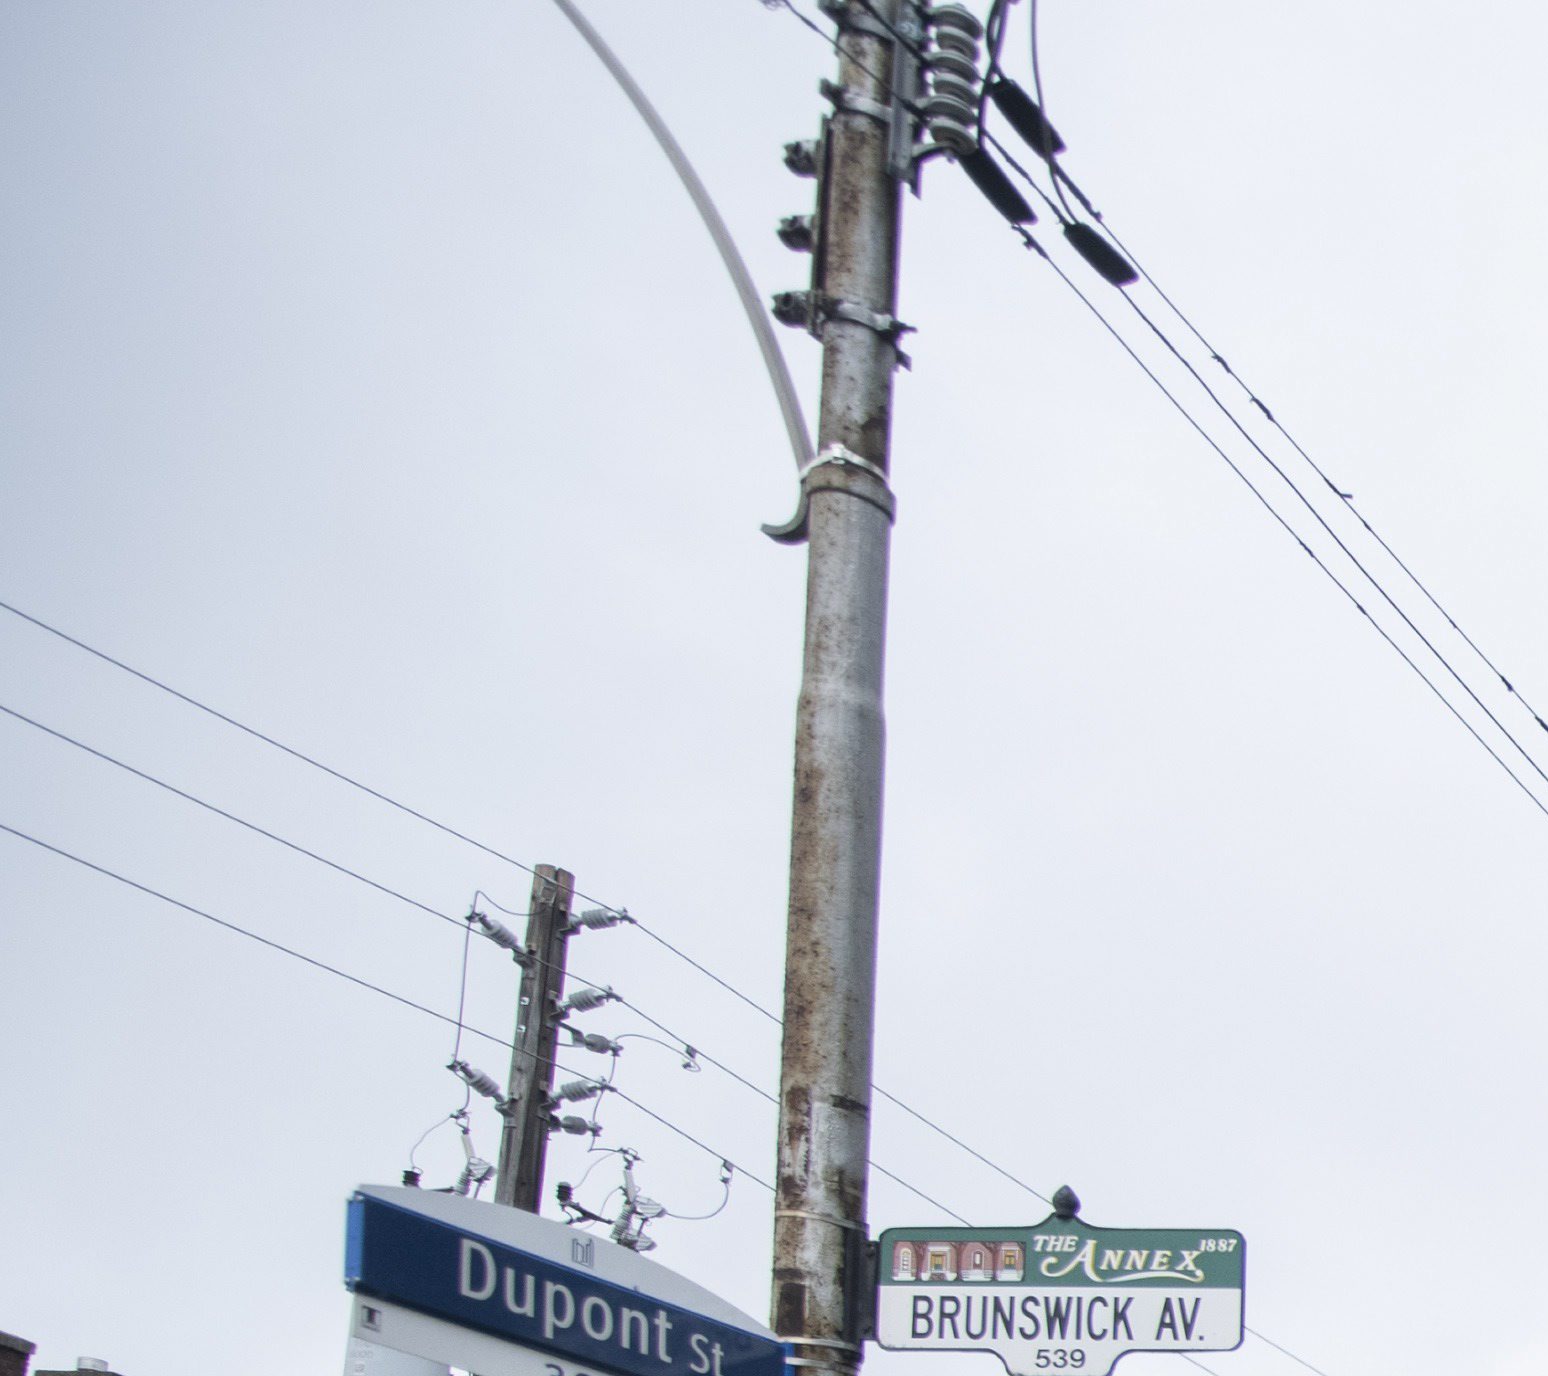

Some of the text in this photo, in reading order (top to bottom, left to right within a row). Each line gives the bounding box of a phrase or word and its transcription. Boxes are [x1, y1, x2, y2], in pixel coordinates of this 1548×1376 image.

[1034, 1235, 1238, 1282] THE ANNEX 1887
[459, 1238, 672, 1364] Dupont
[911, 1295, 1205, 1341] BRUNSWICK AV.
[1035, 1348, 1086, 1369] 539
